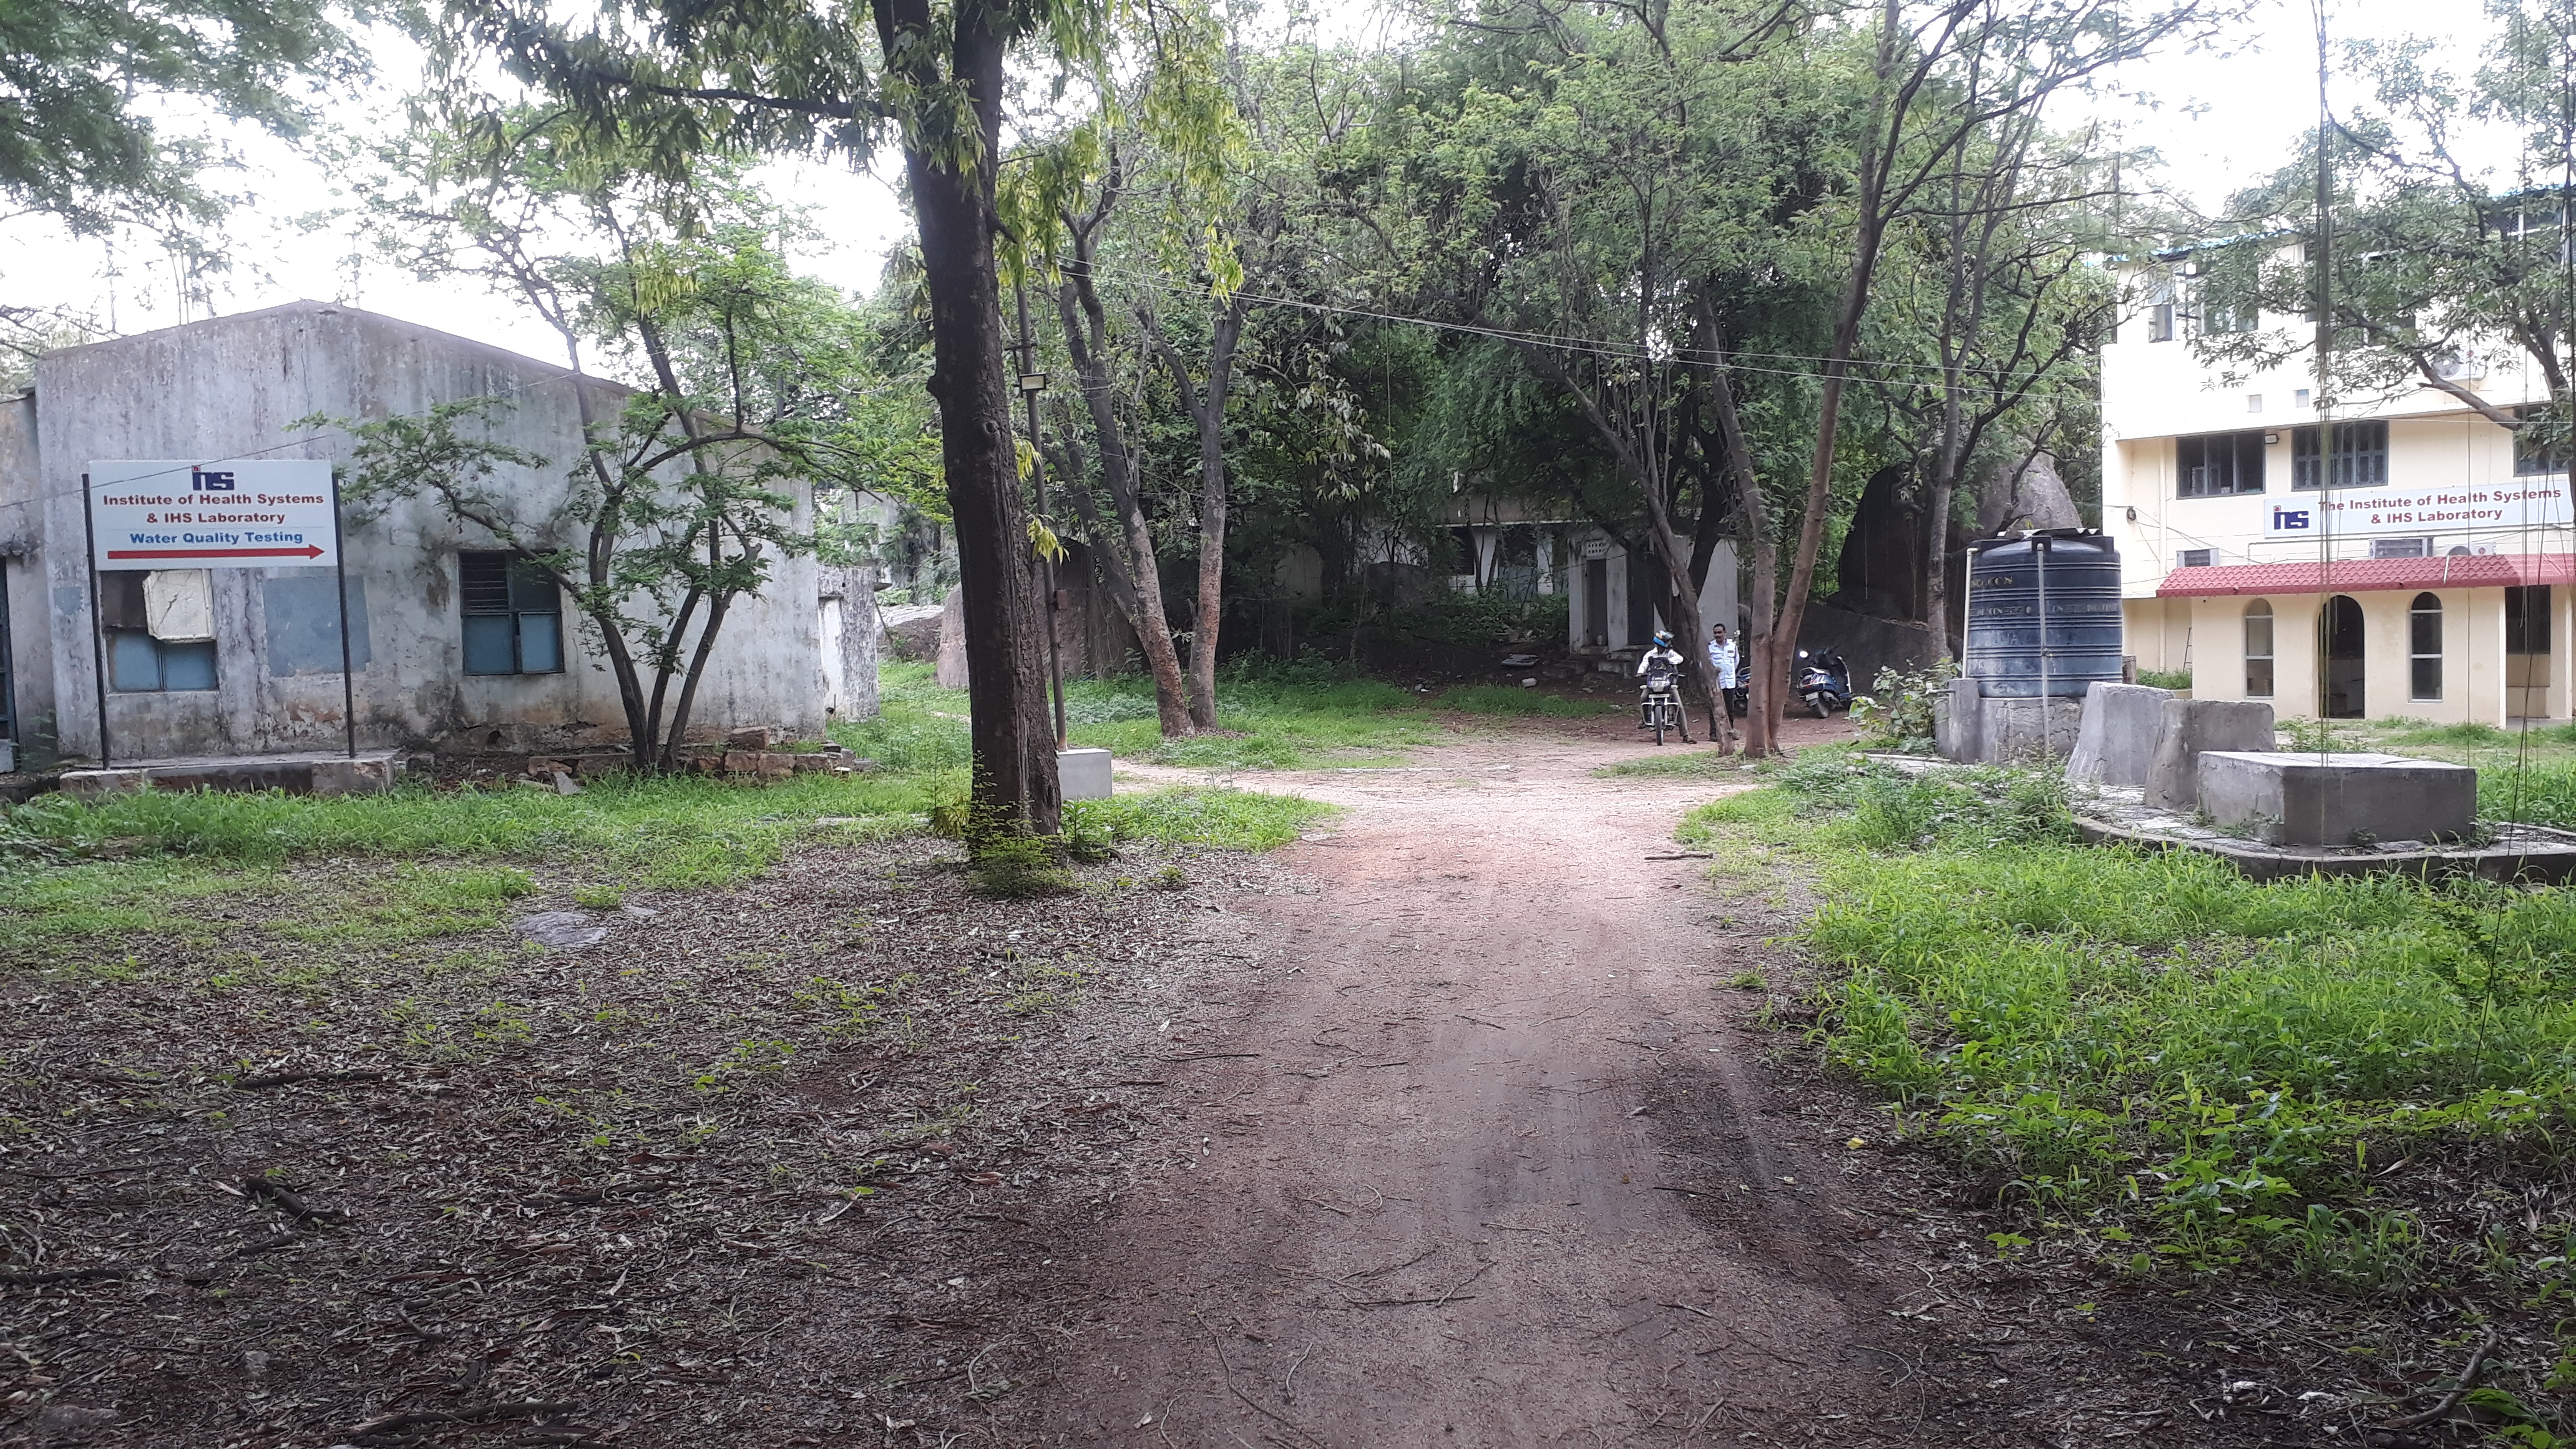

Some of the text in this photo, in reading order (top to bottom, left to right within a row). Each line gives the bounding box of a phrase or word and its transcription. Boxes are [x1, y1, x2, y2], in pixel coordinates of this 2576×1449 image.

[104, 494, 324, 506] Institute of Health Systems
[2318, 488, 2561, 511] The Institute of Health Systems
[147, 512, 285, 524] & IHS Laboratory
[2371, 509, 2503, 524] & IHS Laboratory
[130, 532, 303, 544] Water Quality Testing
